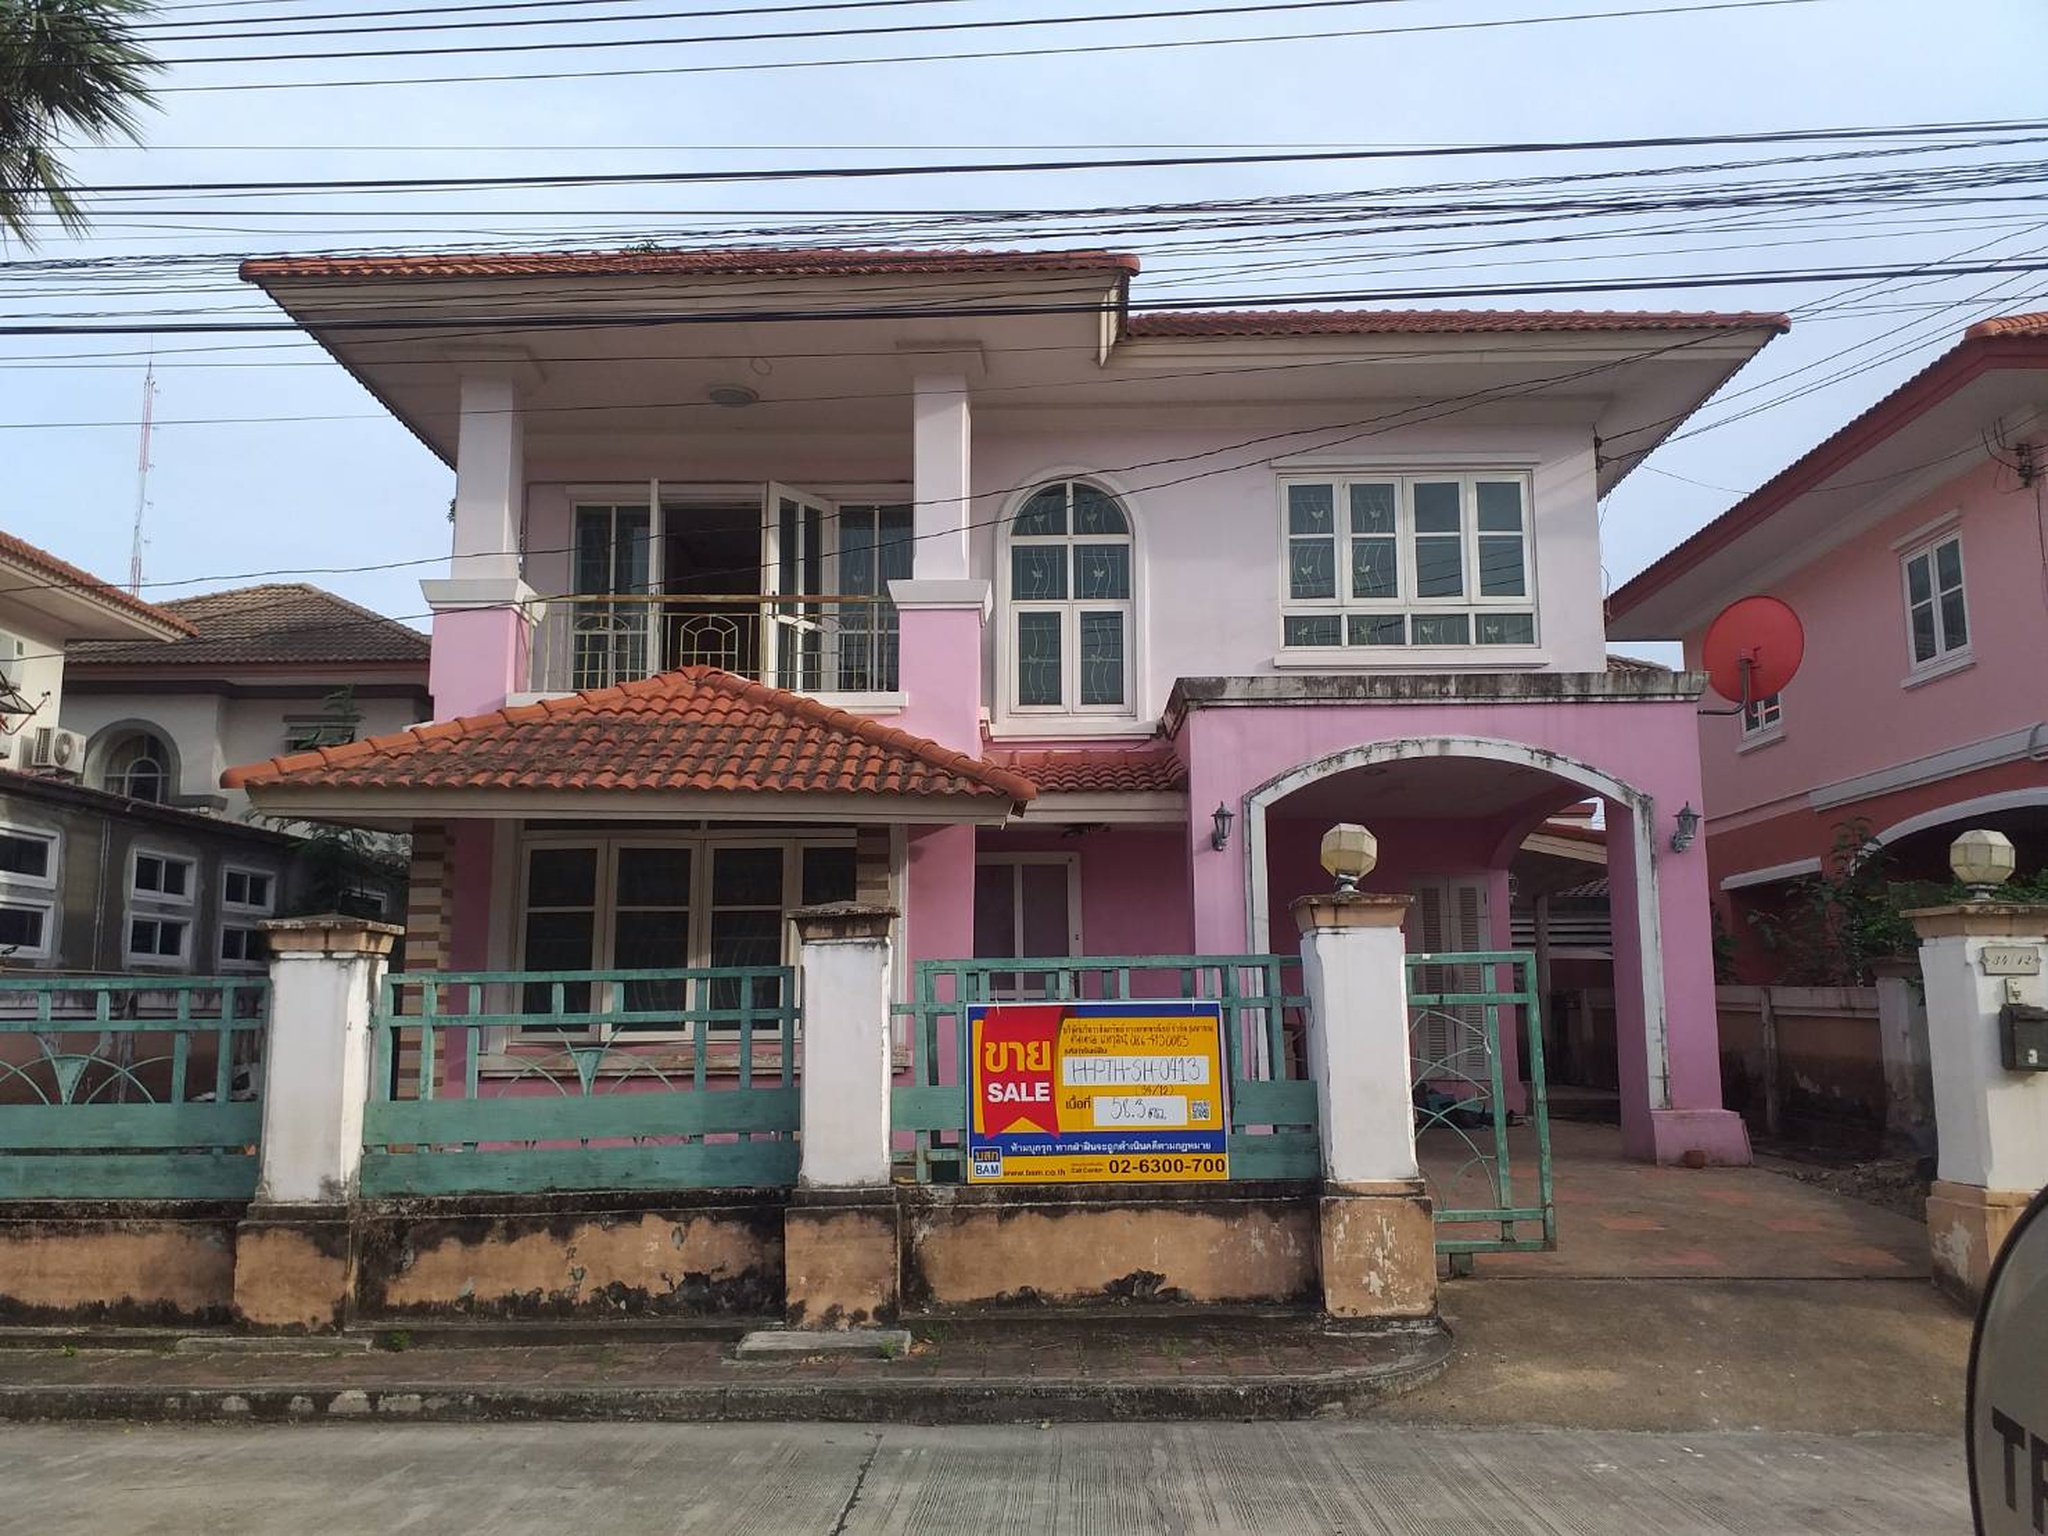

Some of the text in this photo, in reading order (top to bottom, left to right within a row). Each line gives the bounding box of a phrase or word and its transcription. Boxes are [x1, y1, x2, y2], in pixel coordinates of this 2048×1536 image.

[985, 1041, 1050, 1072] ขาย
[987, 1082, 1050, 1103] SALE
[1066, 1094, 1091, 1110] เนื้อที่
[1010, 1141, 1052, 1155] ห้ามบุกรุก
[975, 1164, 999, 1175] BAM
[1109, 1158, 1225, 1174] 02-6300-700
